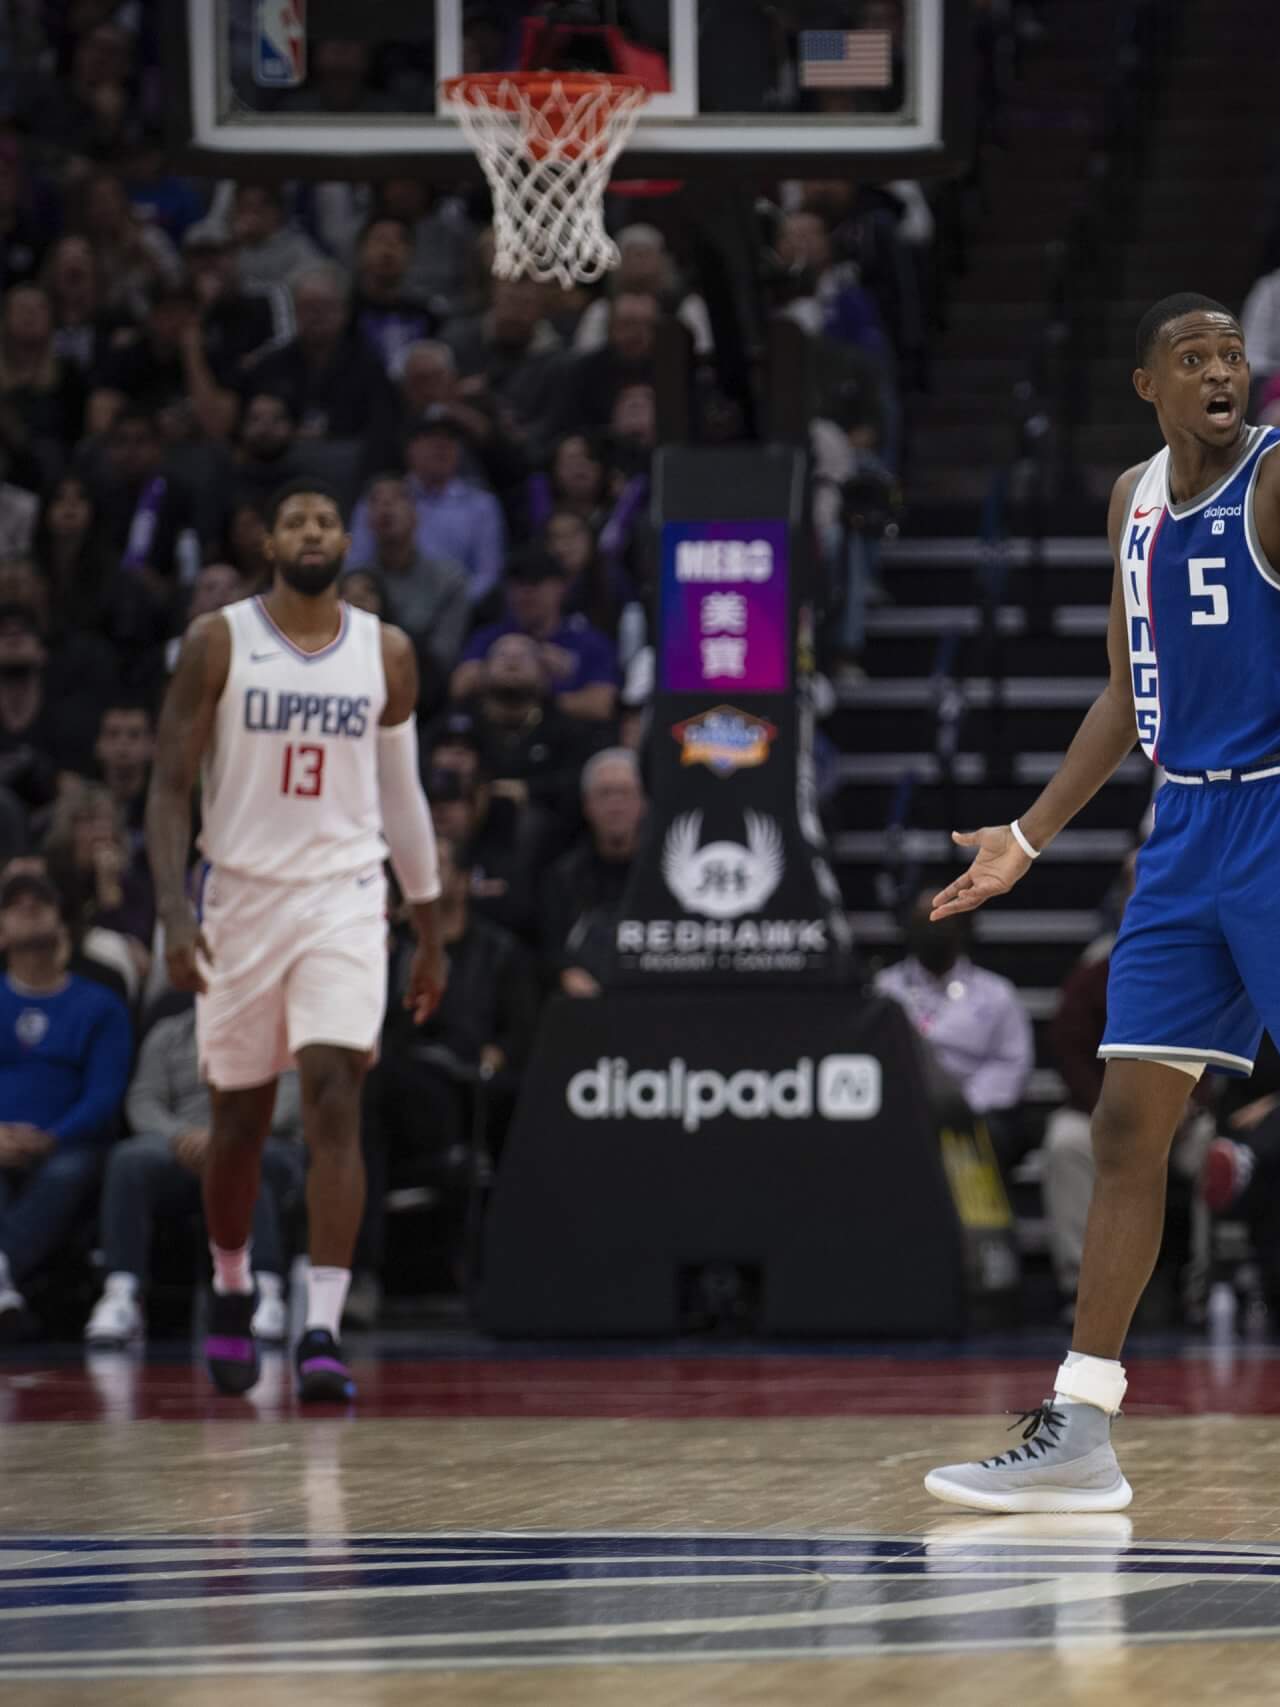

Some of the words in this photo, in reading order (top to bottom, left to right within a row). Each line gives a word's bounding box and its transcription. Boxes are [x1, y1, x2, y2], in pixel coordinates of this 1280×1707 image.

[1203, 504, 1242, 519] dalpad
[1187, 557, 1229, 626] 5
[1127, 525, 1158, 744] KINGS
[243, 688, 370, 738] CLIPPERS
[280, 743, 326, 799] 13
[617, 919, 828, 952] REDHAWK
[567, 1057, 814, 1132] dialpad
